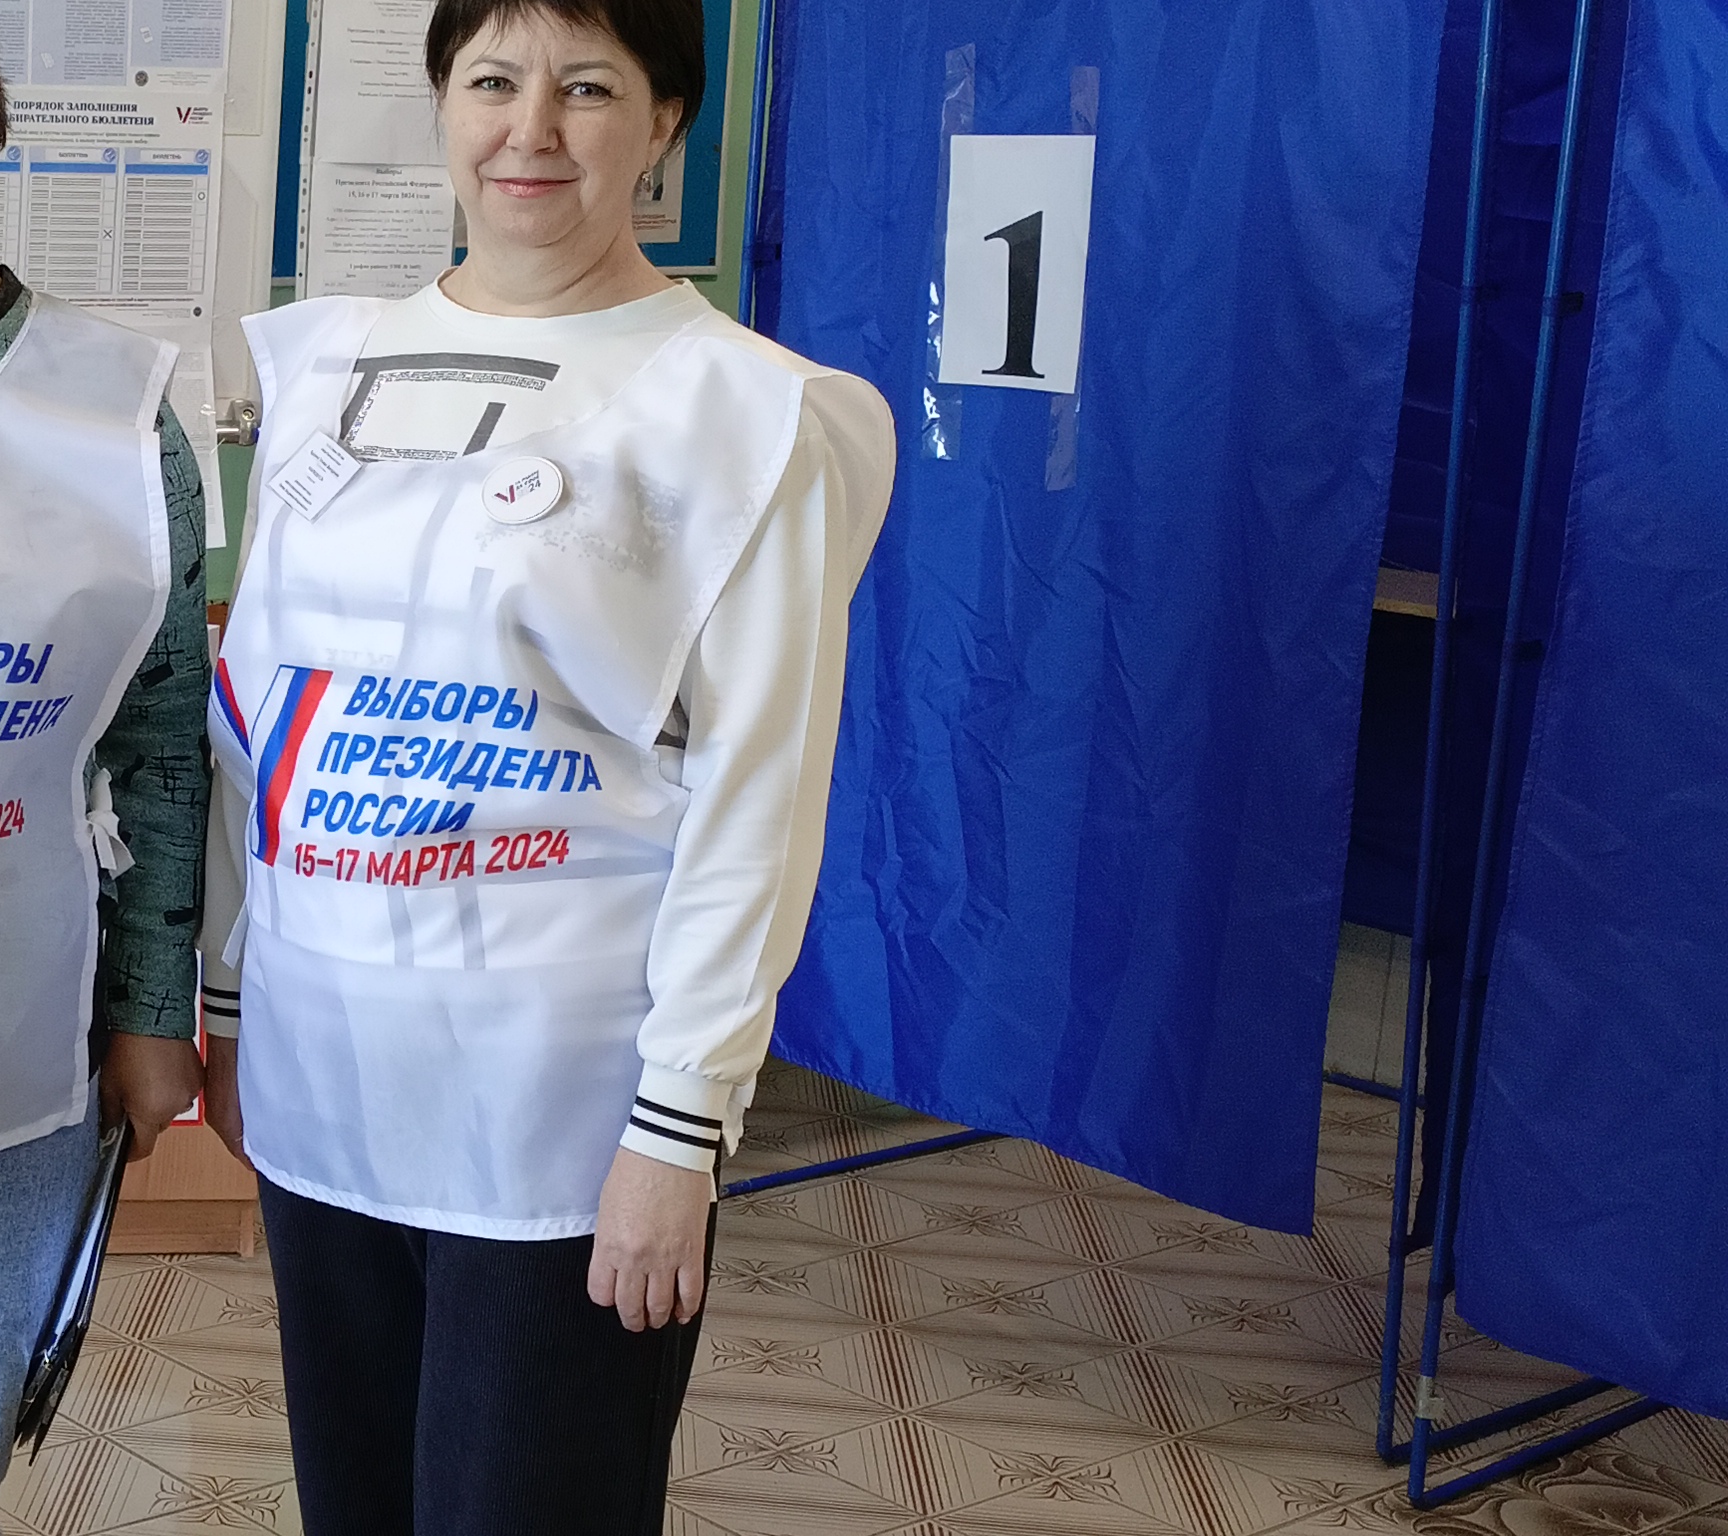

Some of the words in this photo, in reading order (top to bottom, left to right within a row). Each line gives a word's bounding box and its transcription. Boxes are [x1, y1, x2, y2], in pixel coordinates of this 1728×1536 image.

[8, 114, 89, 124] БИРАТЕЛЬНОГО
[91, 115, 154, 125] БЮЛЛЕТЕНЯ
[13, 101, 64, 112] ПОРЯДОК
[67, 102, 138, 113] ЗАПОЛНЕНИЯ
[982, 210, 1045, 379] 1
[343, 675, 538, 731] ВЫБОРЫ
[317, 732, 602, 792] ПРЕЗИДЕНТА
[300, 789, 475, 837] РОССИИ
[366, 840, 475, 886] МАРТА
[485, 829, 569, 874] 2024
